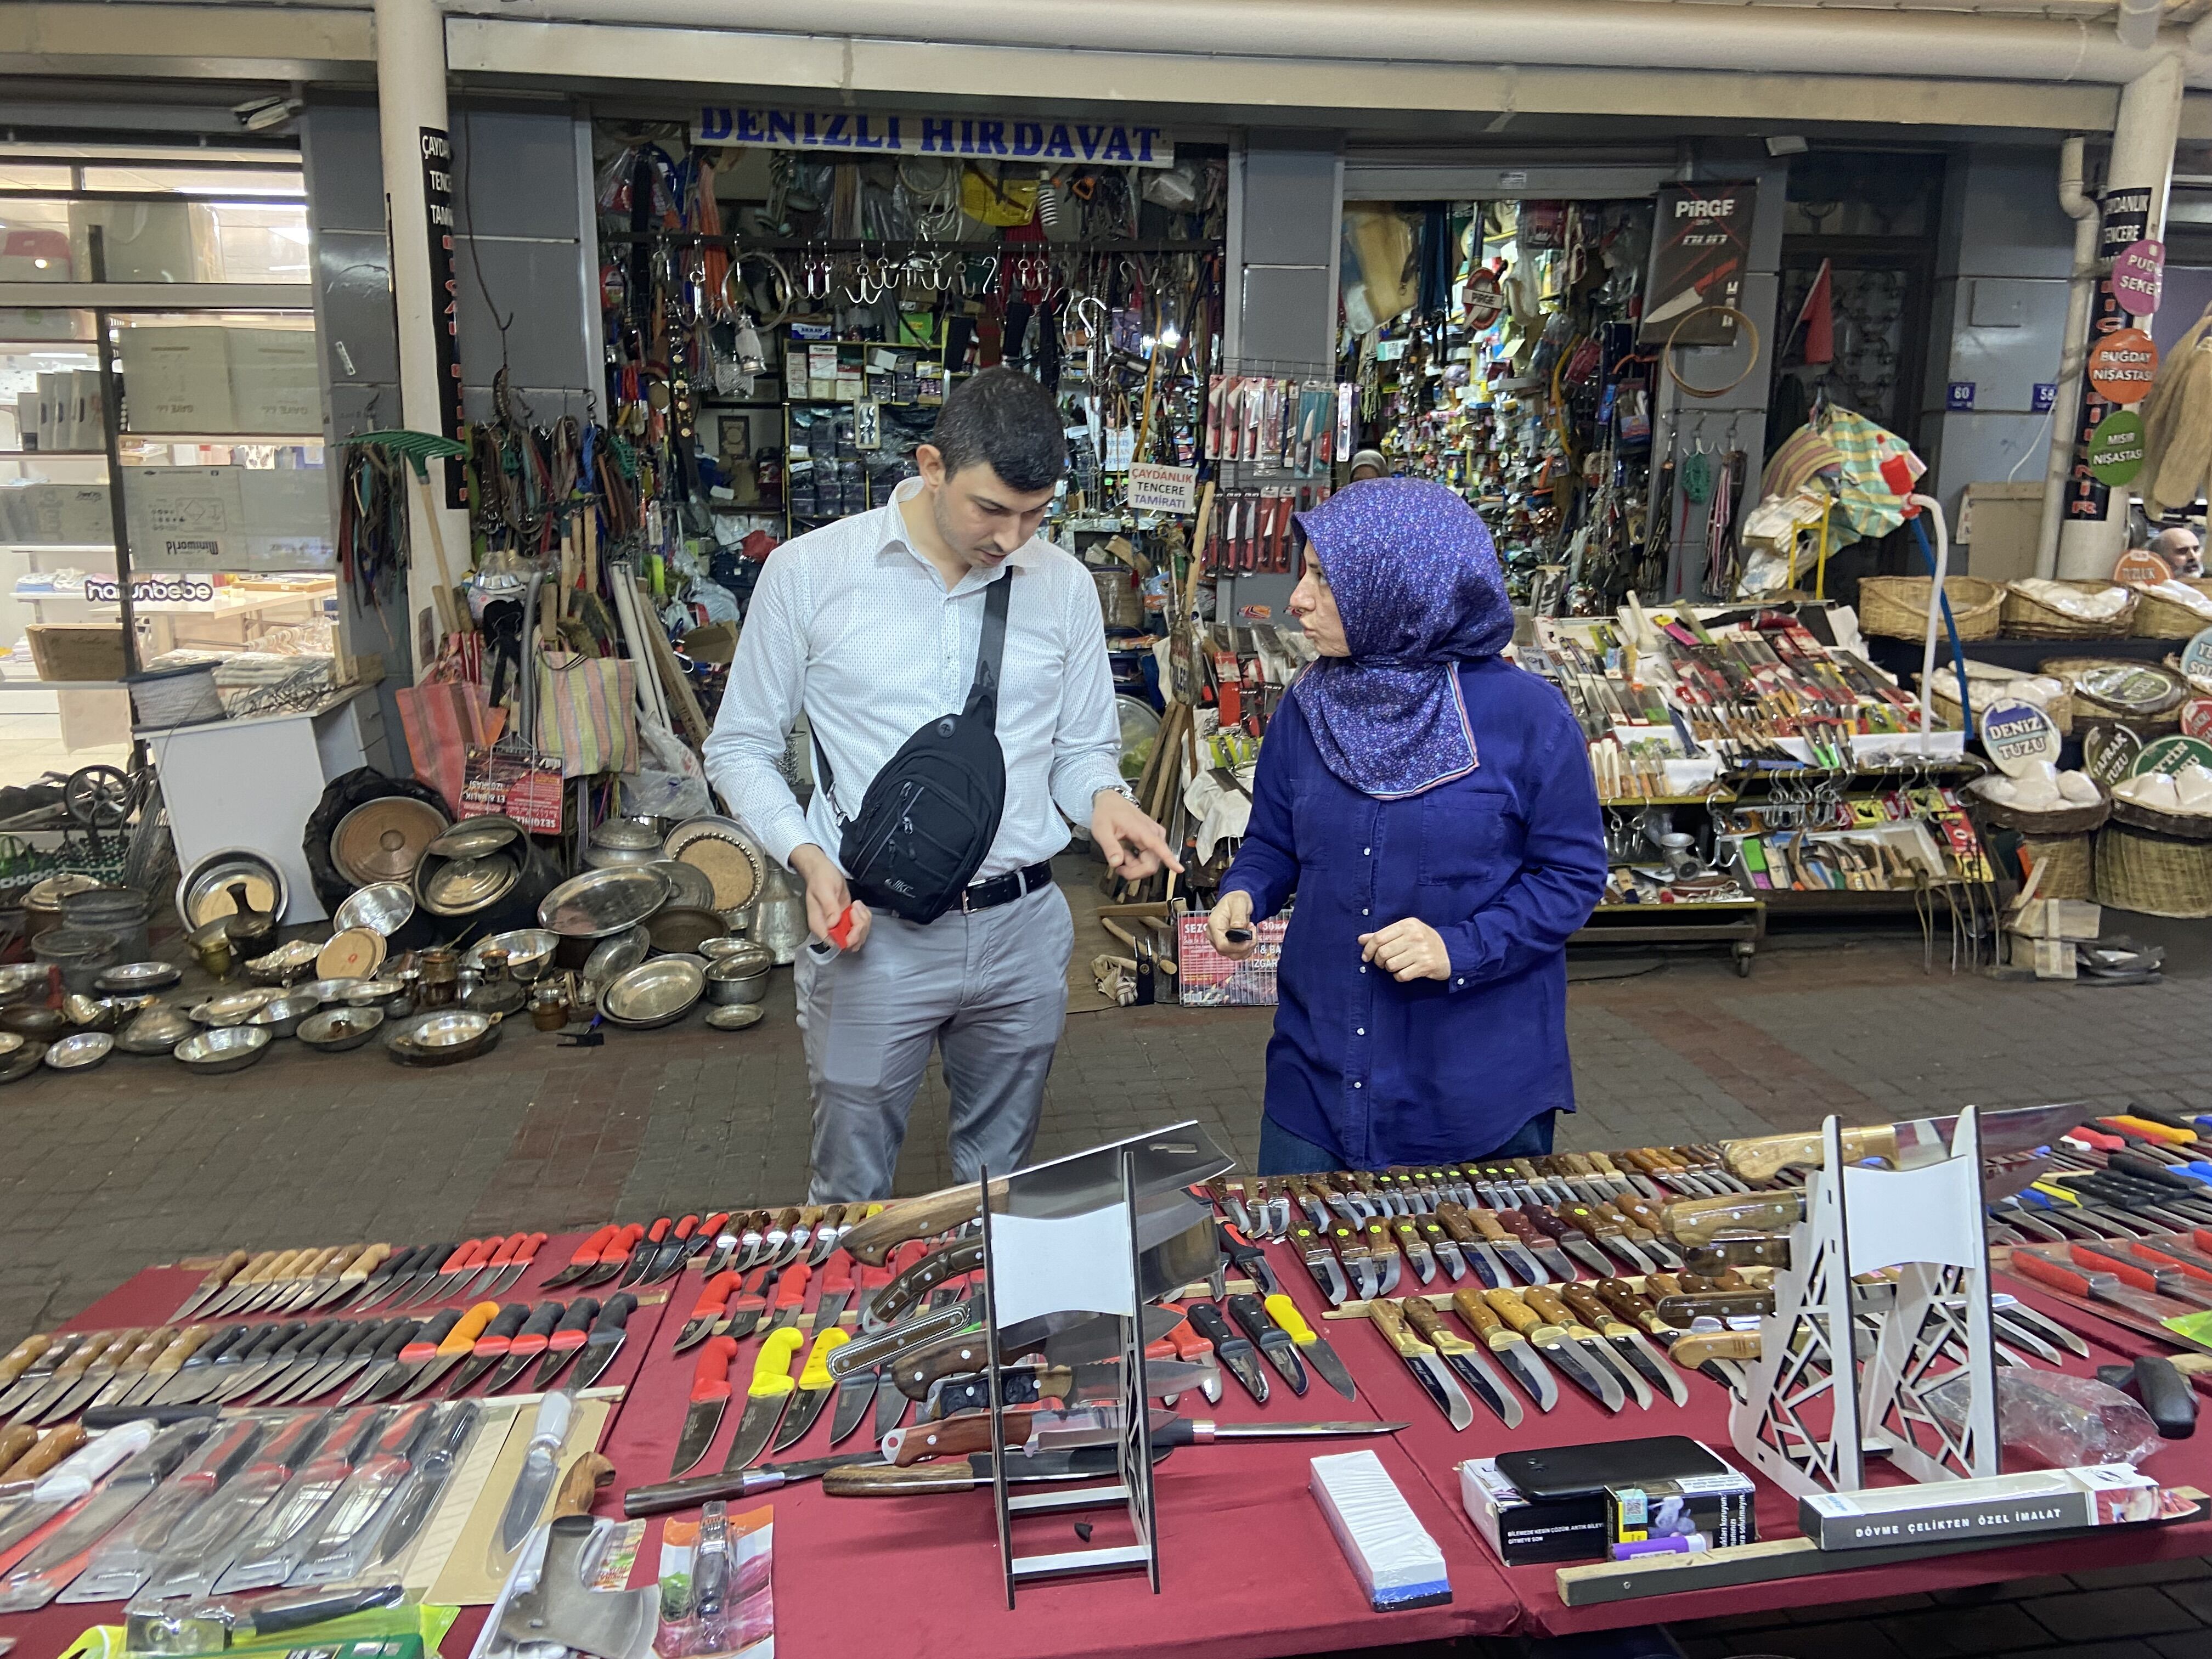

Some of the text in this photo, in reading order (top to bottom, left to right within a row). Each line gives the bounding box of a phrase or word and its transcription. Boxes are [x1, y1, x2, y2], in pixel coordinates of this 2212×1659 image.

[921, 118, 1160, 162] HIRDAVAT
[1954, 387, 1970, 399] 60
[2040, 388, 2056, 401] 58
[1132, 468, 1193, 483] ÇAYDANLIK
[1137, 481, 1186, 495] TENCERE
[1134, 494, 1186, 508] TAMİRATI
[1988, 716, 2042, 740] DENİZ
[1998, 737, 2046, 759] TUZU
[2106, 752, 2129, 785] TUZU
[1855, 1509, 2062, 1538] DÖVME ÇELİKTEN ÖZEL İMALAT
